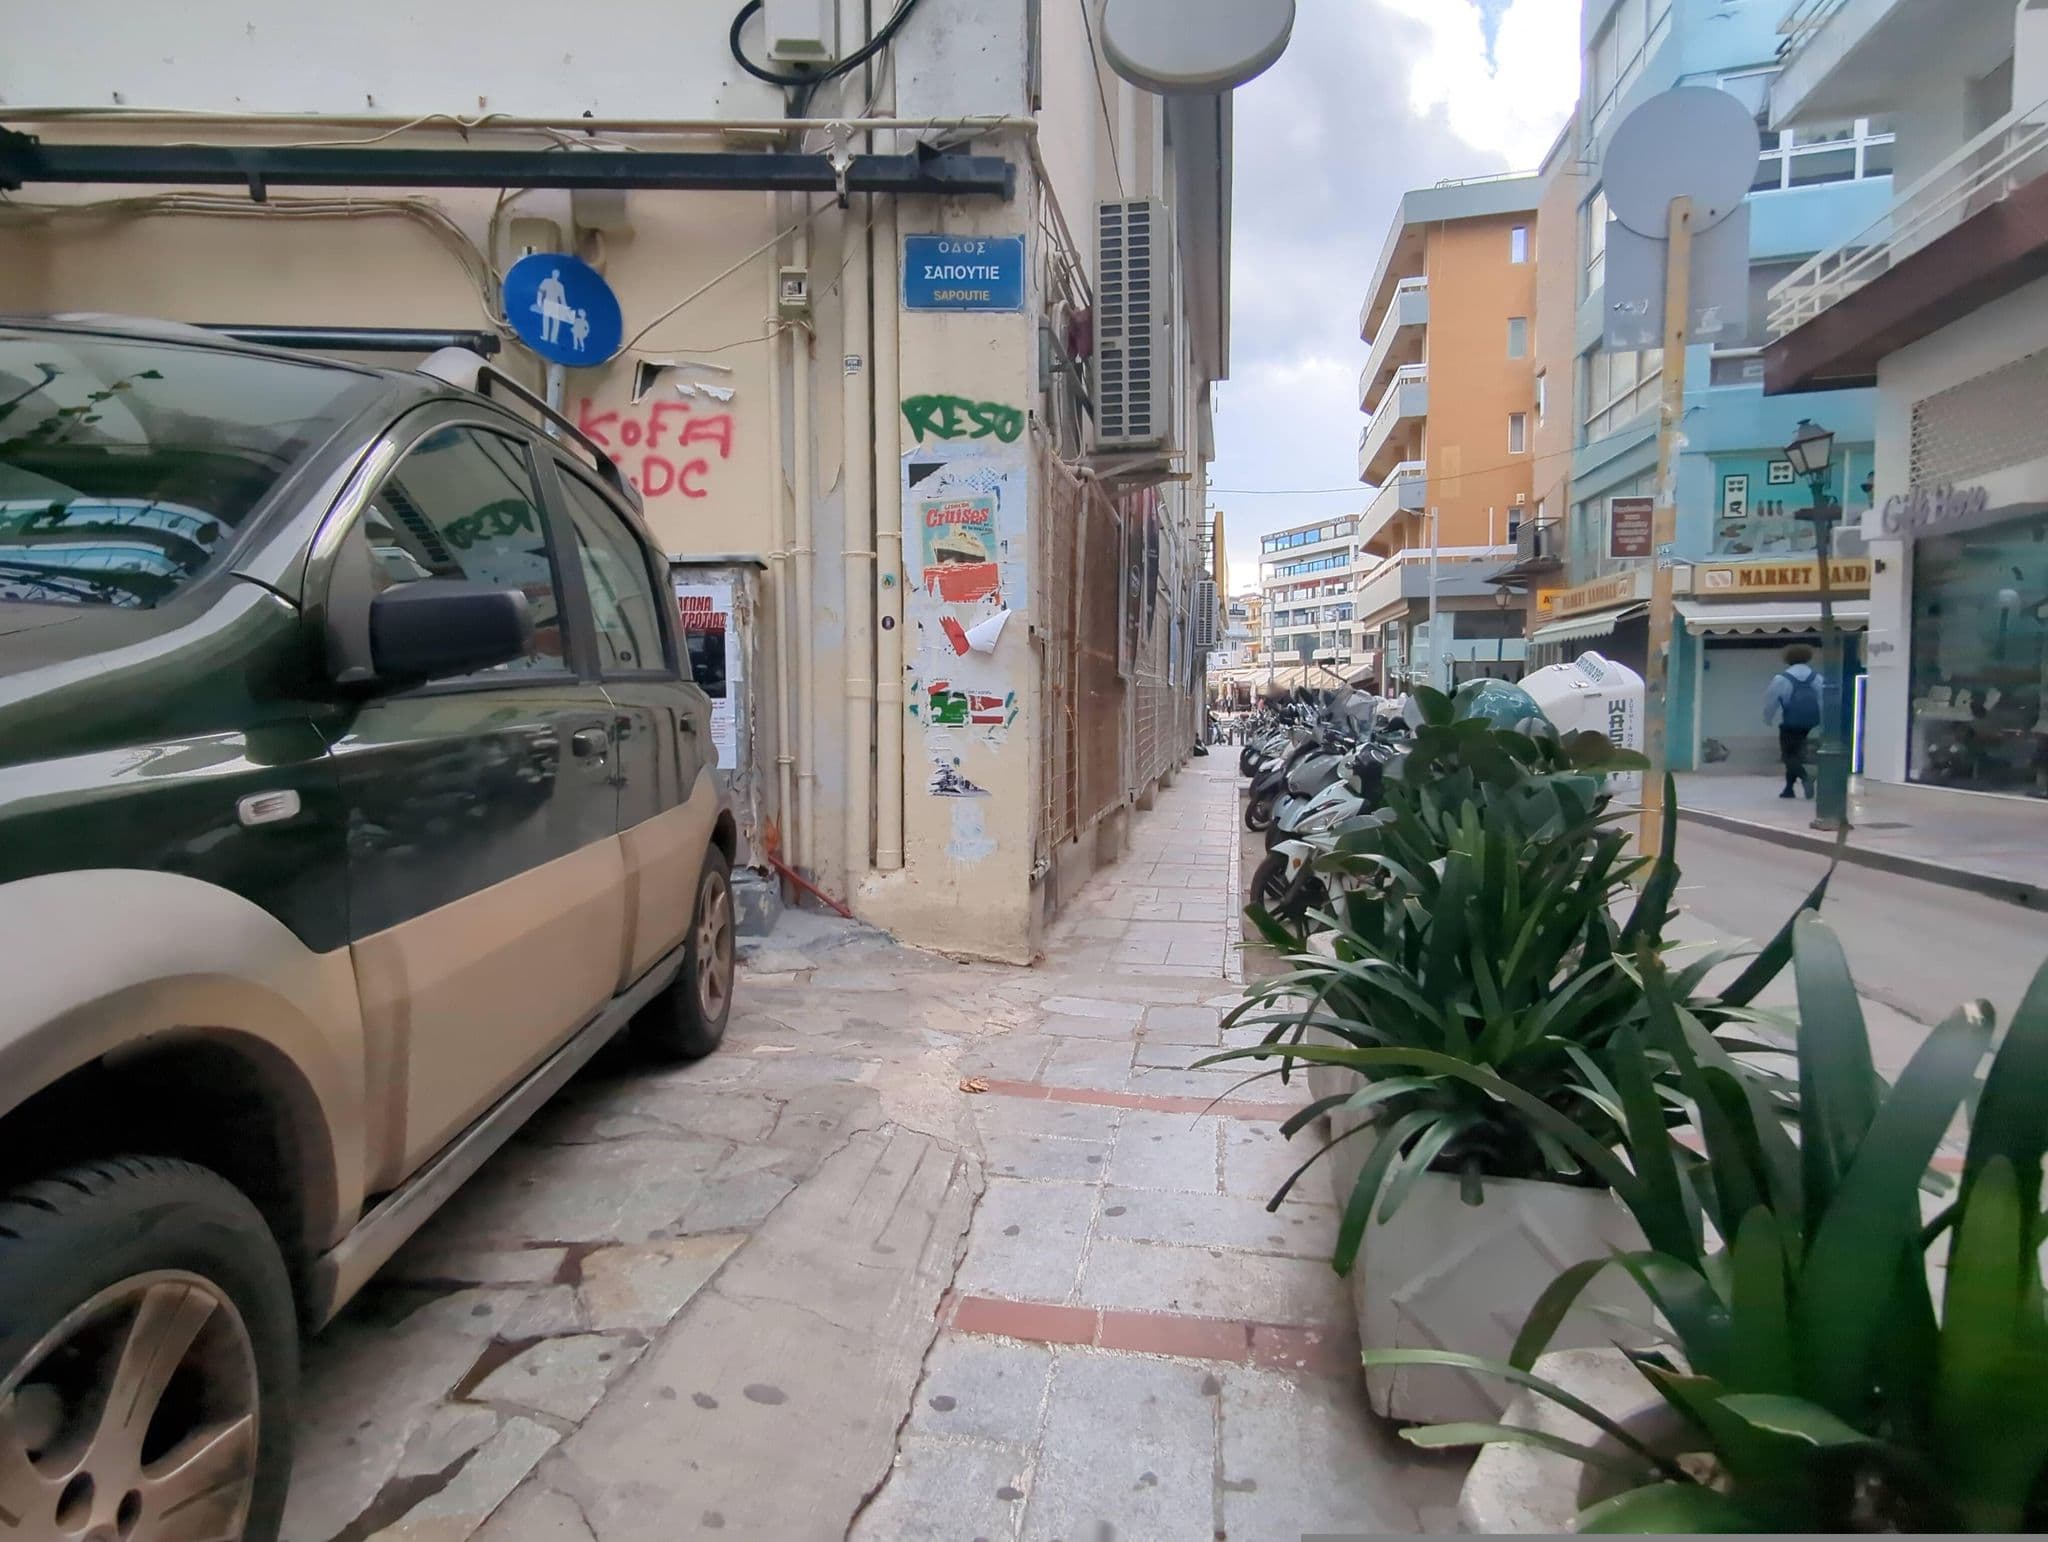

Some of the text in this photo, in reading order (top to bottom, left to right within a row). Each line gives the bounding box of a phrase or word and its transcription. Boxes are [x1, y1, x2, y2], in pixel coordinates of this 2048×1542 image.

[938, 241, 986, 255] ΟΔΟΣ
[923, 265, 1000, 280] ΣΑΠΟΥΤΙΕ
[933, 290, 991, 301] SAPOUTIE
[901, 394, 1025, 443] RESO
[610, 453, 709, 498] DC
[926, 508, 989, 528] Cruises
[1739, 565, 1872, 587] MARKET AND
